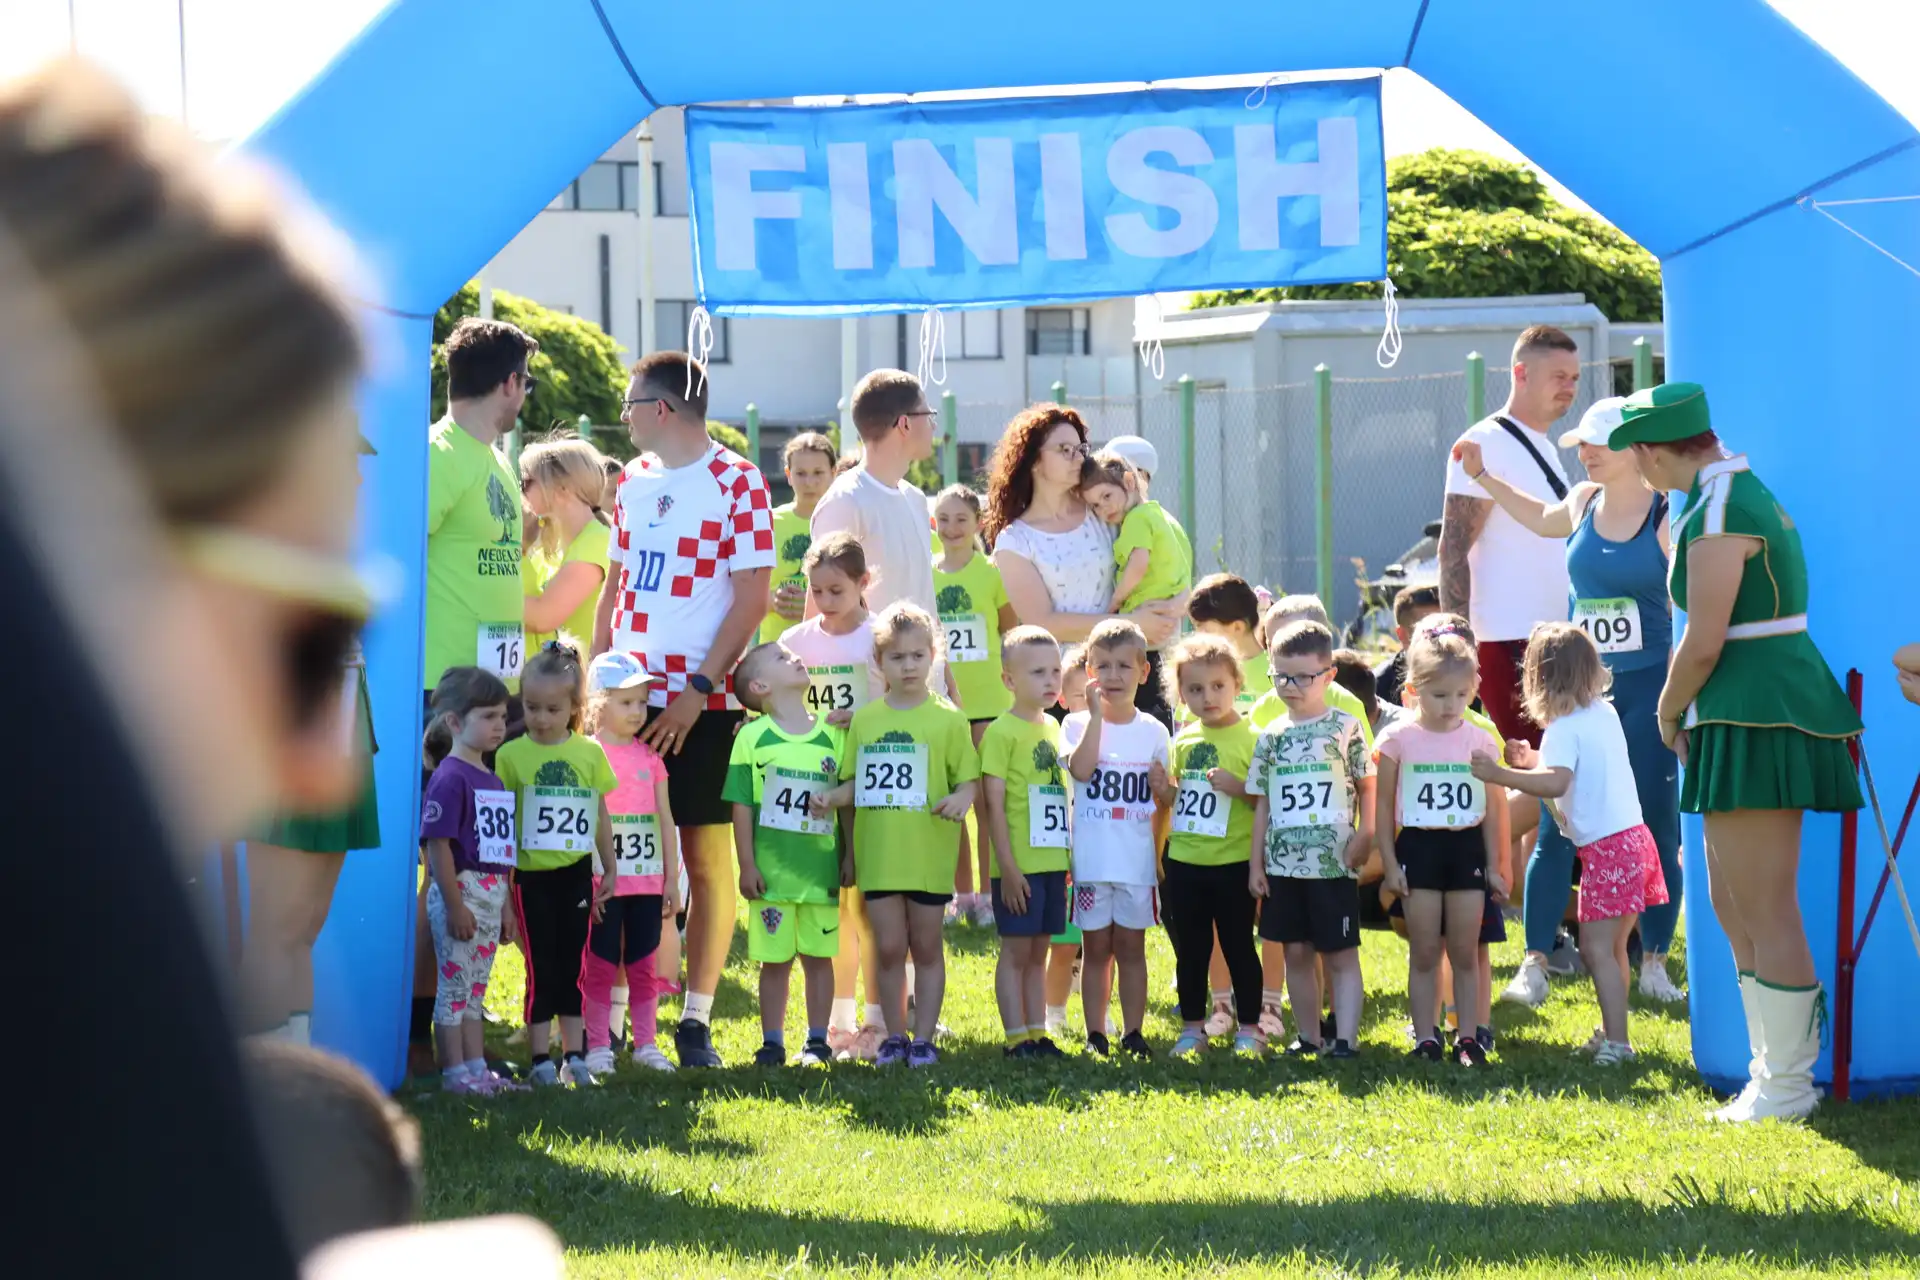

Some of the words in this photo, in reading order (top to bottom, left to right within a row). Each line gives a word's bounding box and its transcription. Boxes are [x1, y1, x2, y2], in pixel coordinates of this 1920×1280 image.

[709, 116, 1360, 271] FINISH
[478, 548, 521, 562] NEDELS
[478, 562, 518, 576] CENKA
[633, 550, 665, 592] 10
[949, 629, 977, 649] 21
[1580, 616, 1631, 643] 109
[496, 640, 518, 670] 16
[807, 684, 854, 710] 443
[865, 762, 913, 790] 528
[1086, 768, 1151, 803] 3800
[775, 787, 811, 816] 44
[1176, 789, 1217, 819] 520
[1281, 781, 1333, 812] 537
[1417, 782, 1473, 810] 430
[537, 806, 589, 836] 526
[1044, 805, 1068, 831] 51
[1086, 806, 1112, 820] run
[612, 833, 655, 860] 435
[1597, 866, 1624, 884] Style
